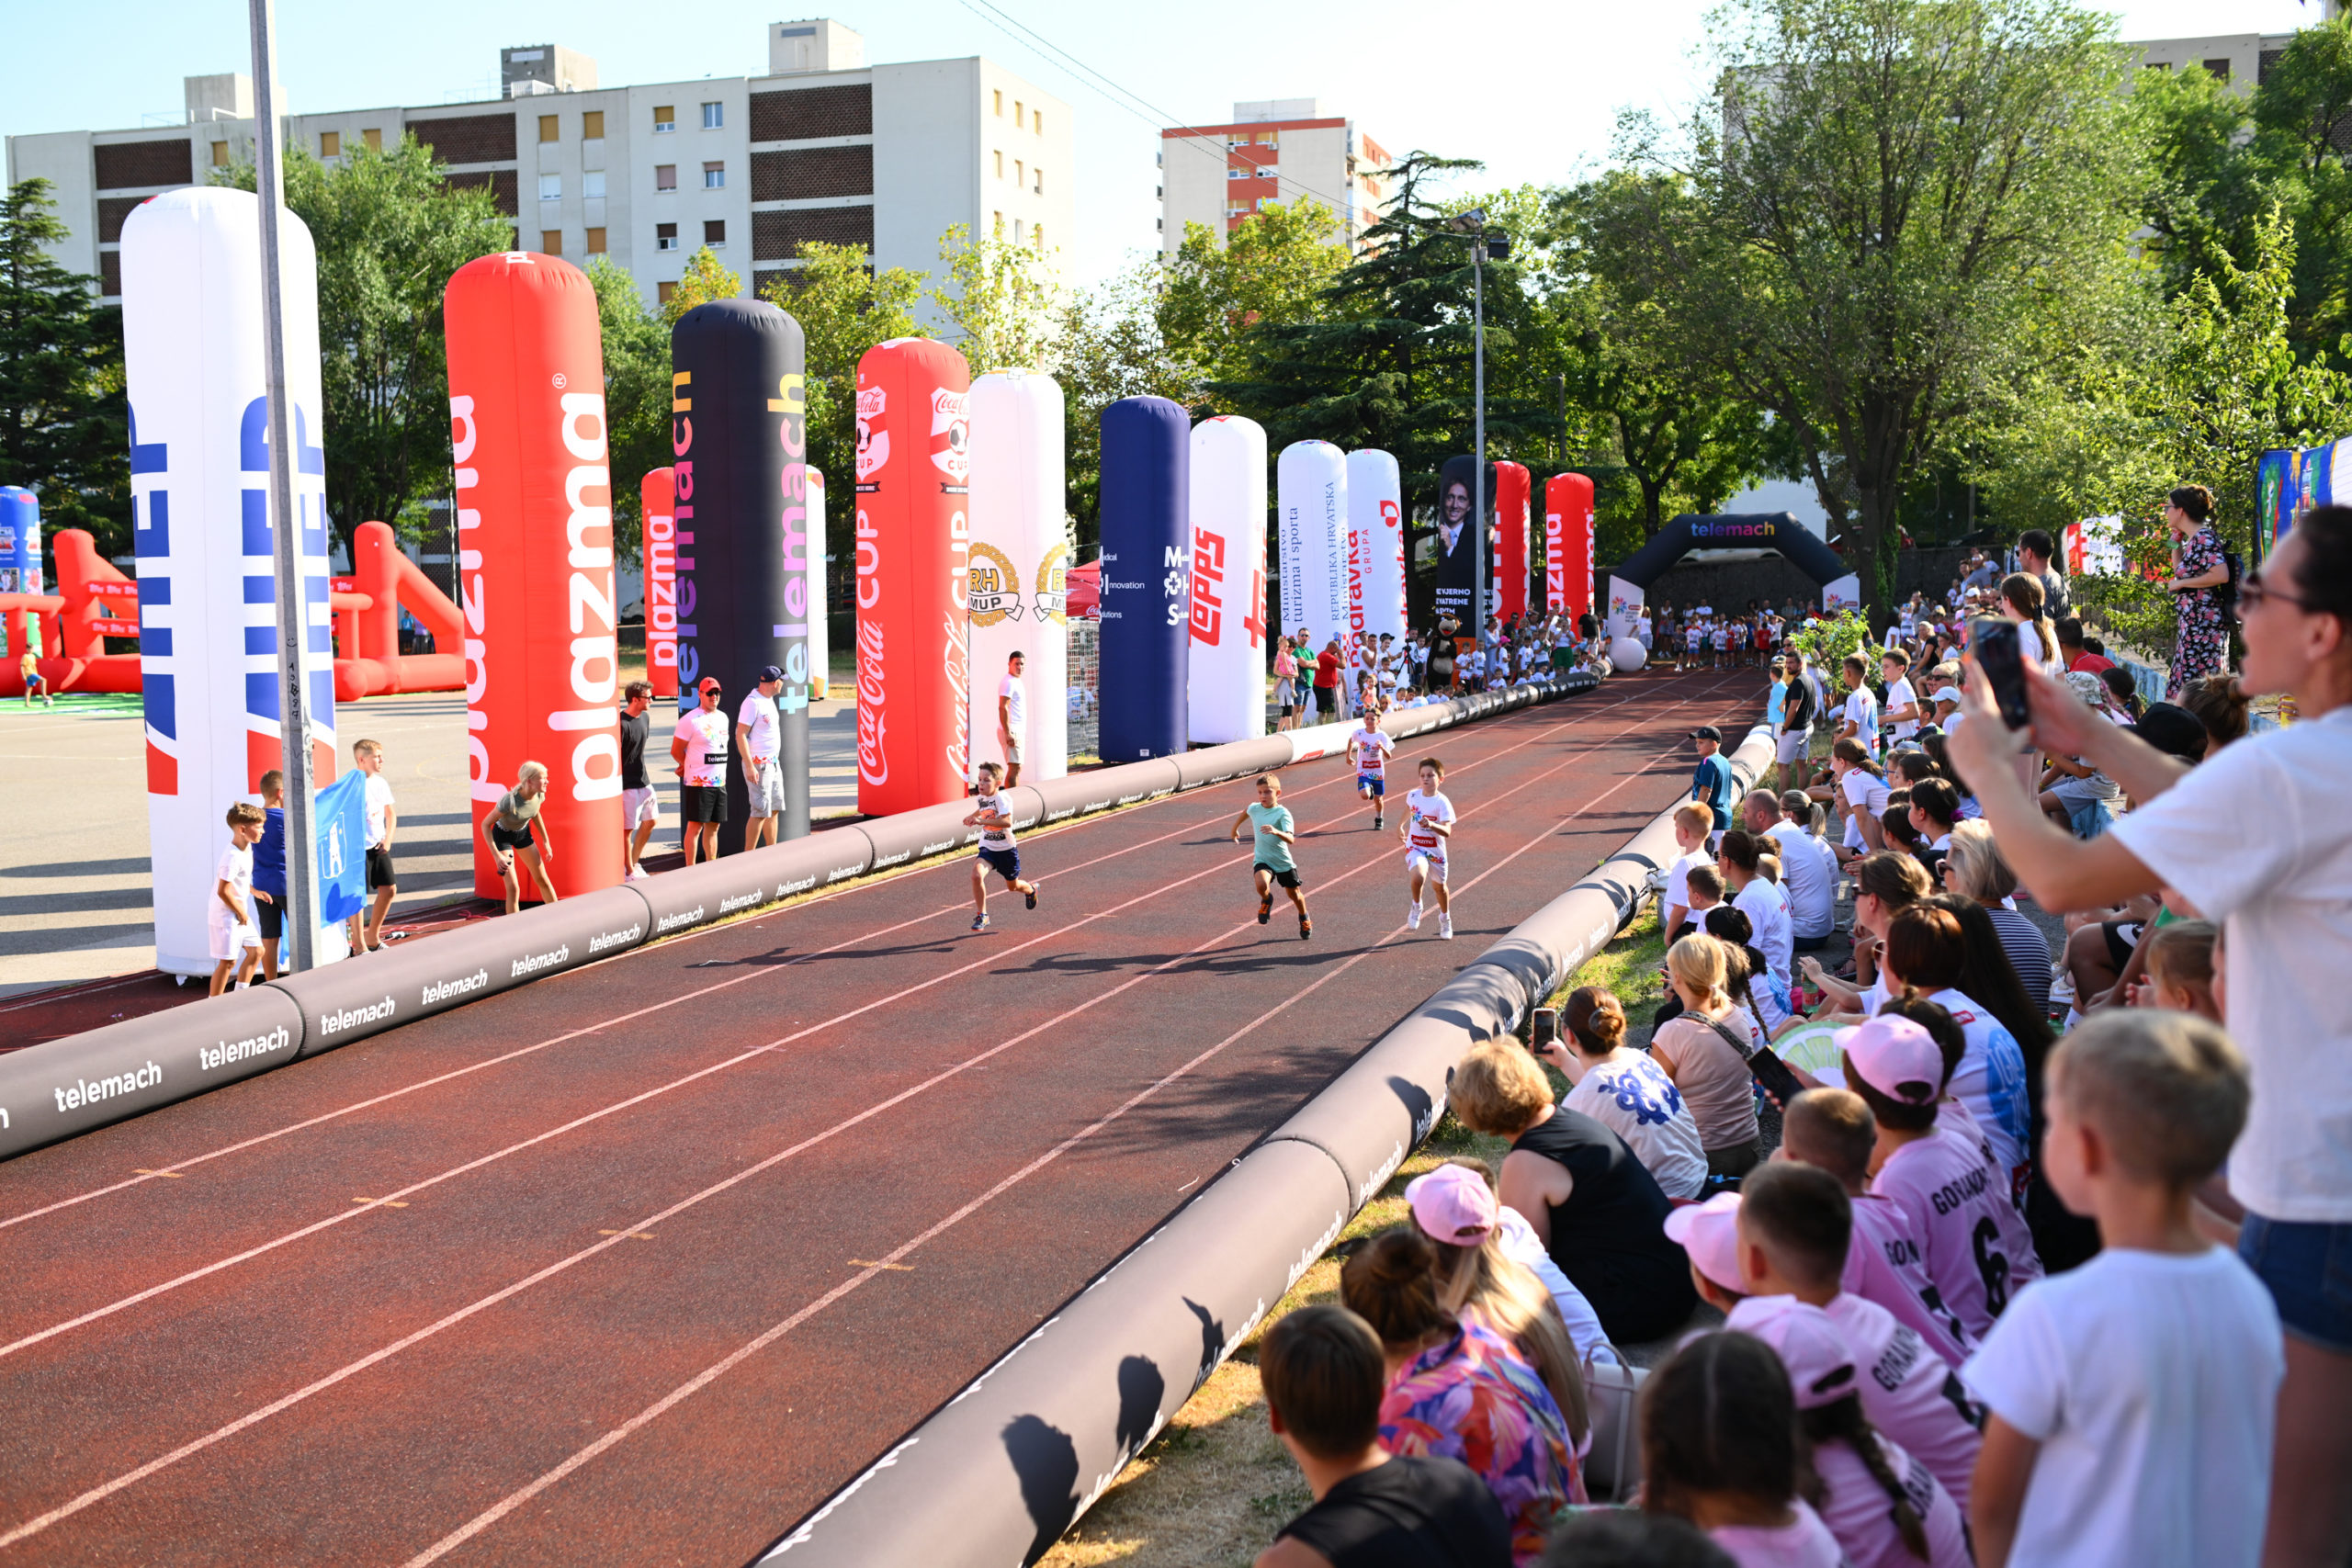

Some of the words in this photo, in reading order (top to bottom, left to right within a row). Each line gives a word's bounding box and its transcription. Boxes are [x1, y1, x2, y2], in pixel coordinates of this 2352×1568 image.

[1289, 507, 1302, 551] sporta
[1325, 482, 1337, 548] HRVATSKA
[1690, 521, 1776, 537] telemach
[767, 372, 808, 715] telemach
[857, 508, 879, 609] CUP
[1361, 528, 1373, 574] GRUPA
[548, 392, 623, 801] plazma
[648, 514, 677, 667] plazma
[1104, 574, 1145, 595] Innovation
[1290, 568, 1304, 623] turizma
[1329, 552, 1340, 622] REPUBLIKA
[874, 849, 911, 869] telemach
[921, 837, 956, 857] telemach
[775, 874, 816, 898] telemach
[827, 861, 865, 884] telemach
[657, 905, 705, 932] telemach
[719, 887, 763, 914] telemach
[589, 922, 641, 953] telemach
[511, 943, 570, 978] telemach
[422, 968, 489, 1006] telemach
[321, 996, 396, 1036] telemach
[199, 1025, 289, 1071] telemach
[54, 1060, 163, 1113] telemach
[1357, 1140, 1402, 1210] telemach
[1285, 1210, 1342, 1294] telemach
[1973, 1216, 2008, 1320] 6
